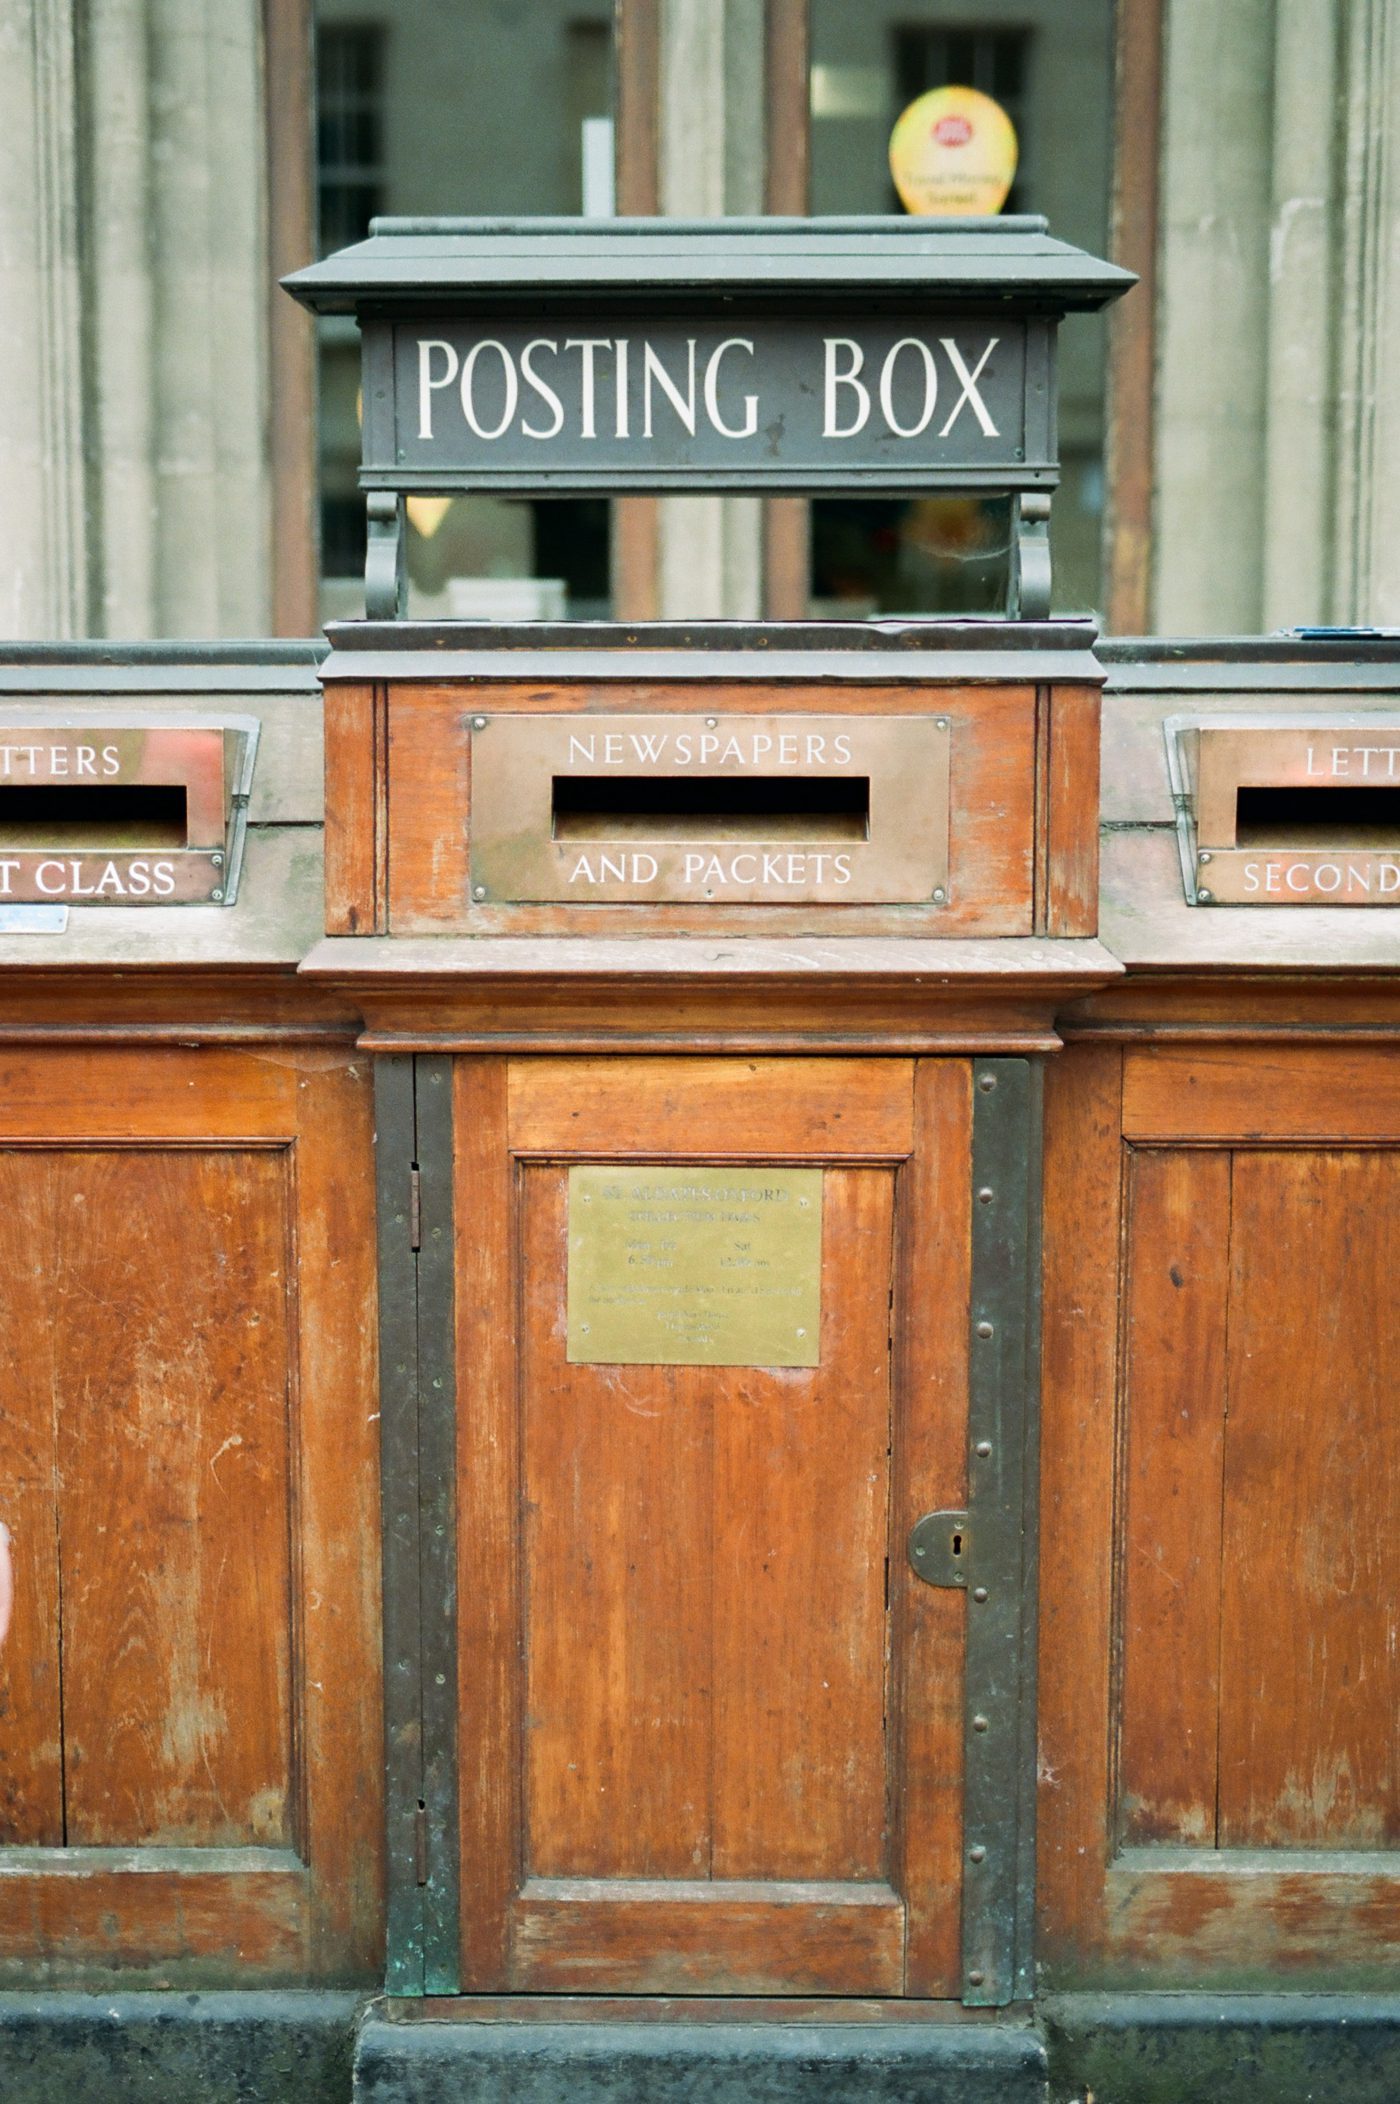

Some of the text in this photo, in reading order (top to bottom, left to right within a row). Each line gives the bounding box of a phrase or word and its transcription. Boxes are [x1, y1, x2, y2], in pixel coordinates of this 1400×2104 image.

[417, 338, 1001, 440] POSTING BOX
[568, 734, 852, 765] NEWSPAPERS
[1306, 747, 1400, 776] LETT
[35, 861, 175, 894] CLASS
[568, 854, 852, 885] AND PACKETS
[1244, 863, 1400, 892] SECOND
